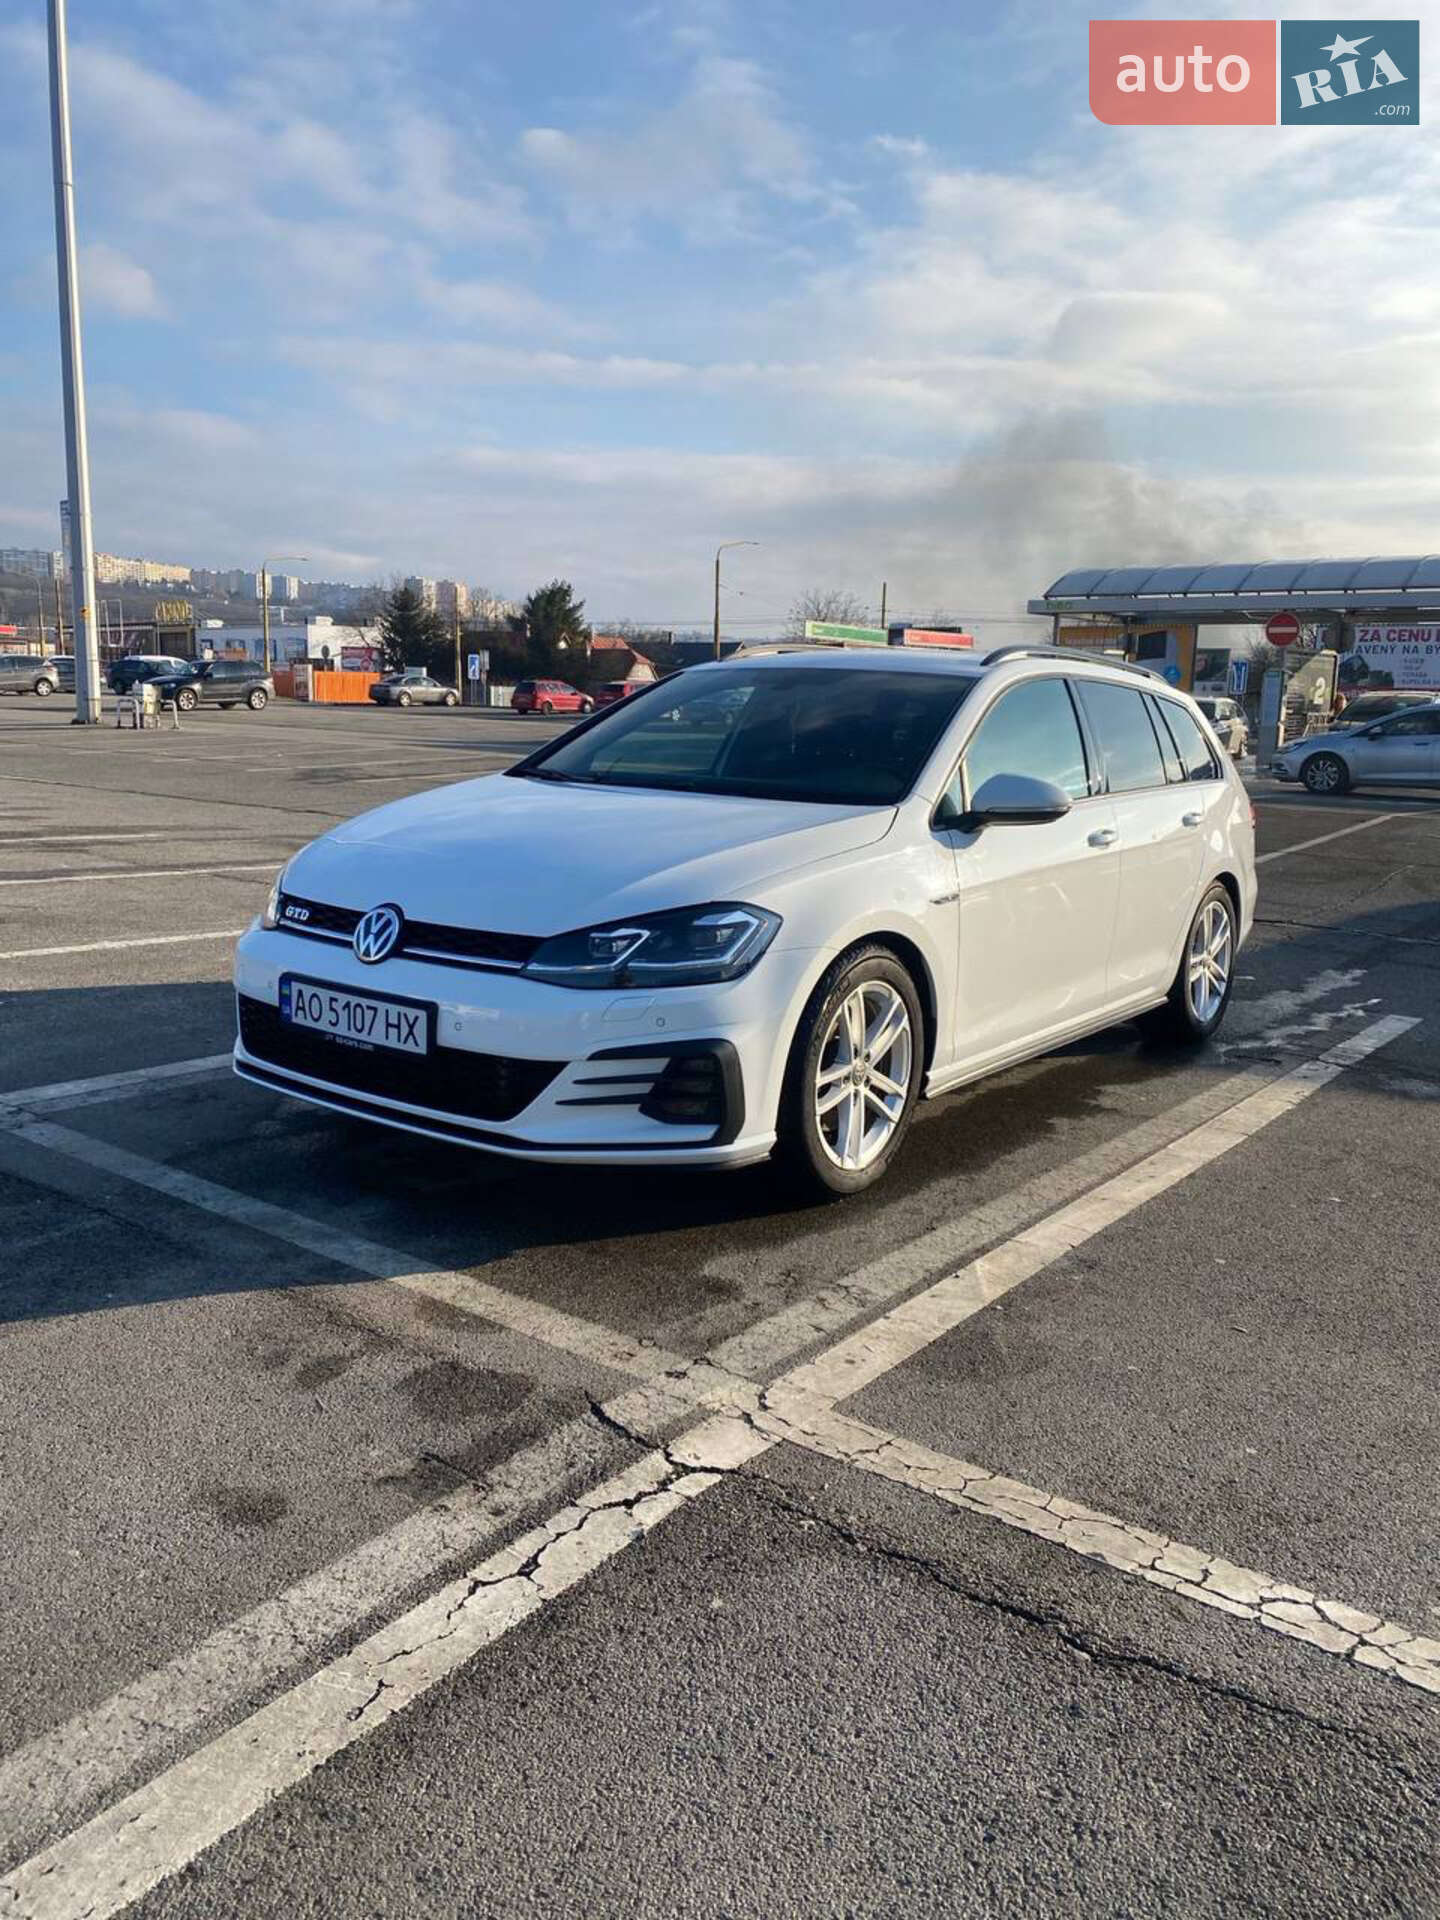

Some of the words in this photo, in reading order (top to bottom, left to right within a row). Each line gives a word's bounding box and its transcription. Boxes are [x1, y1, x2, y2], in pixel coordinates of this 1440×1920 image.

[1359, 629, 1381, 642] ZA
[1386, 628, 1431, 642] CENU
[285, 904, 309, 921] GTD
[294, 988, 323, 1023] AO
[327, 996, 378, 1036] 5107
[384, 1008, 420, 1048] HX
